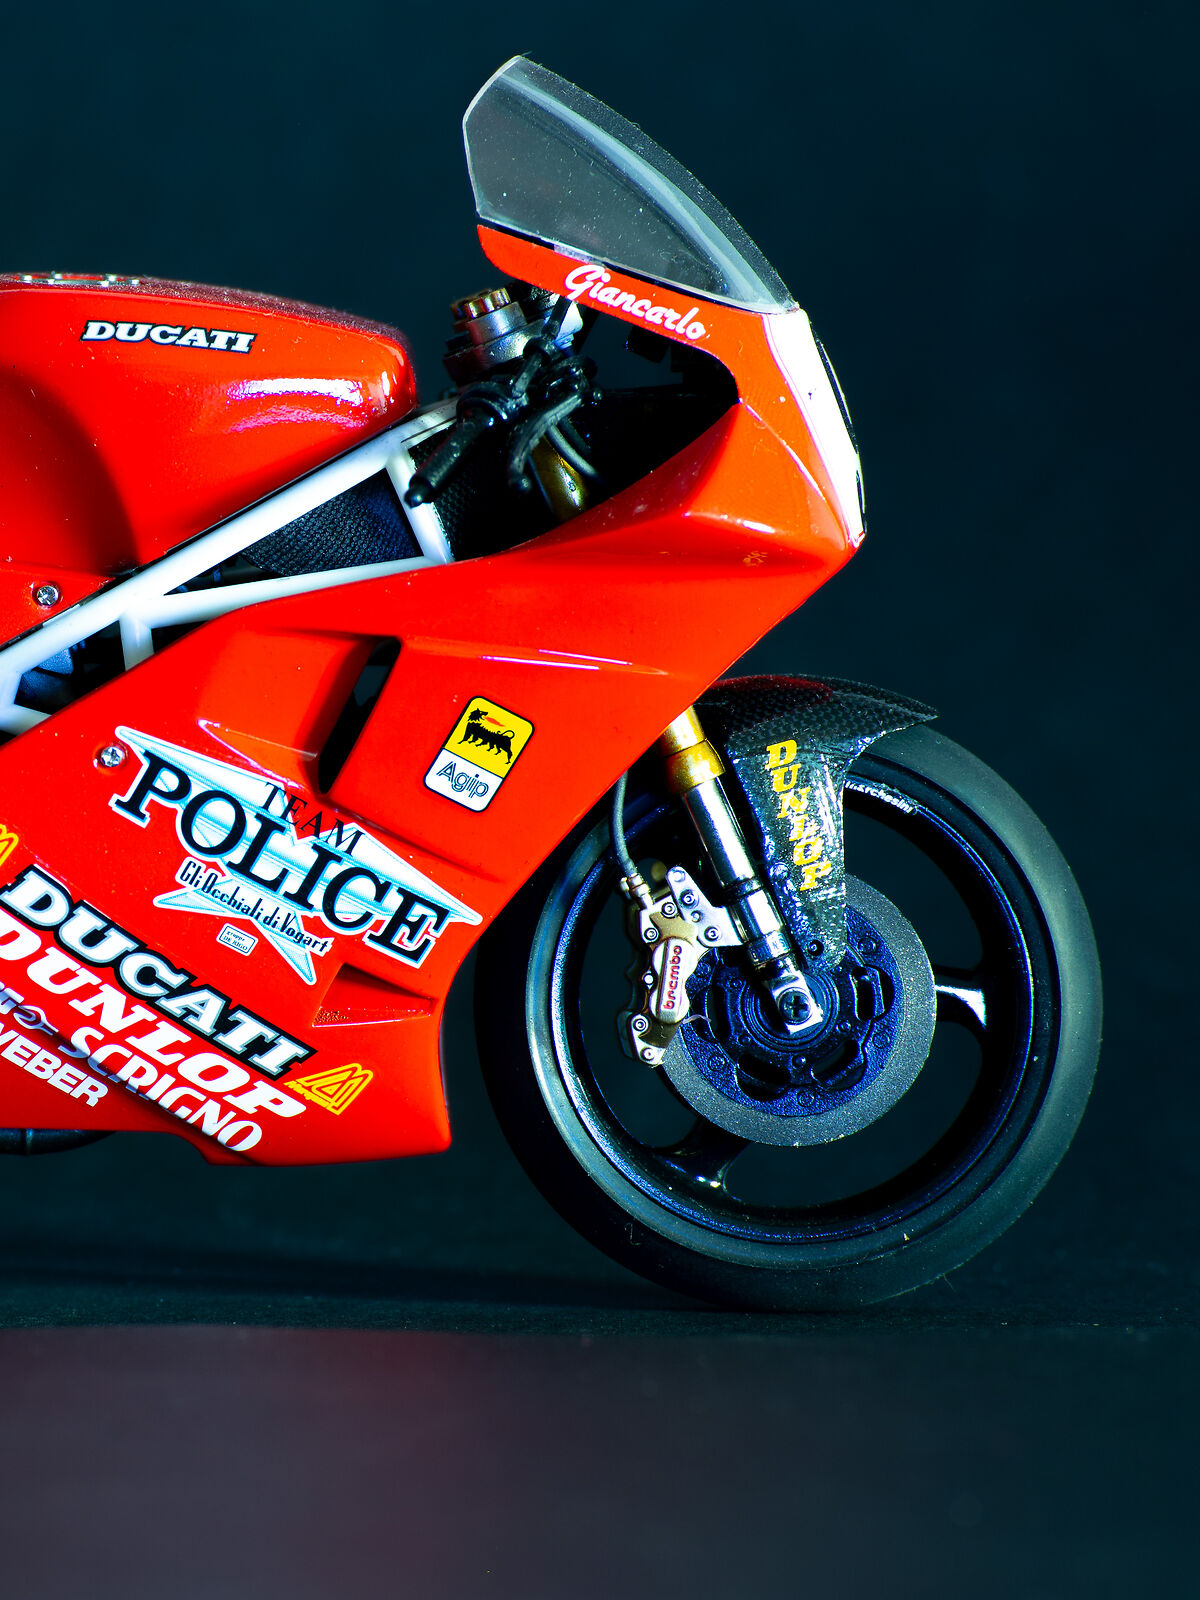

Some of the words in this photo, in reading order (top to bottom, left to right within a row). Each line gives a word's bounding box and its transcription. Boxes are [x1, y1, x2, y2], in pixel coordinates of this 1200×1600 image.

[81, 321, 256, 353] DUCATI
[564, 264, 706, 341] Giancarlo
[436, 760, 490, 799] Agip
[765, 739, 833, 891] DUNLOP
[115, 748, 459, 961] POLICE
[263, 782, 364, 857] TEAM
[179, 860, 203, 888] Gli
[201, 872, 265, 921] Occhiali
[262, 906, 281, 929] di
[279, 911, 330, 953] Vogart
[663, 945, 683, 1010] brembo
[57, 1026, 265, 1153] SCRIGNO
